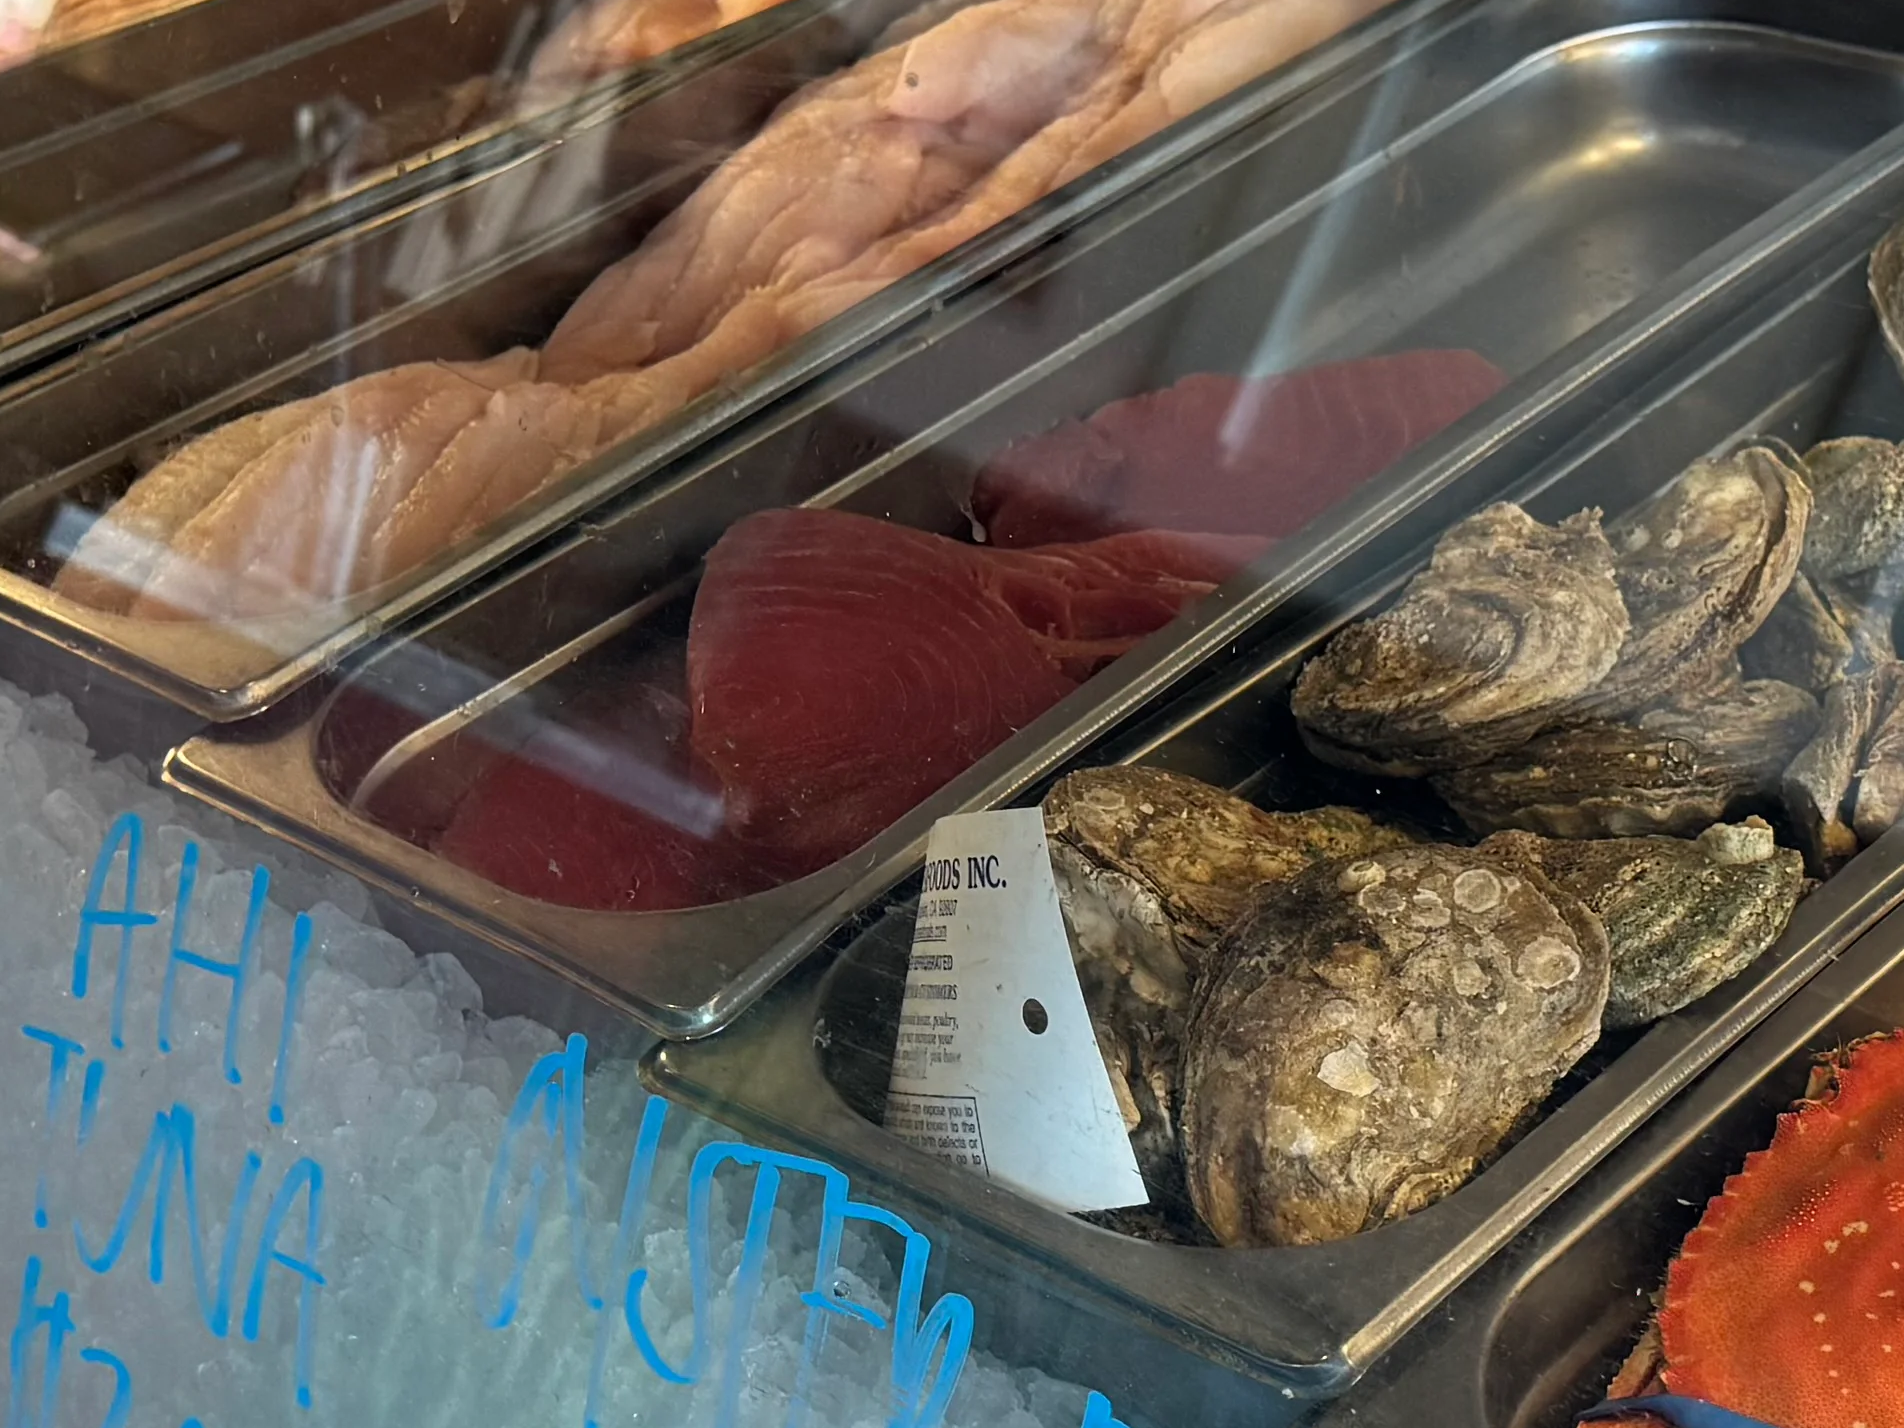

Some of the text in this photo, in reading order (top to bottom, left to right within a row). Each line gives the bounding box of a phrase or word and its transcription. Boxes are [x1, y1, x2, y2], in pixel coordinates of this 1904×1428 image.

[71, 810, 313, 1124] AHI
[967, 855, 1007, 889] INC.
[22, 1025, 326, 1408] TUNA
